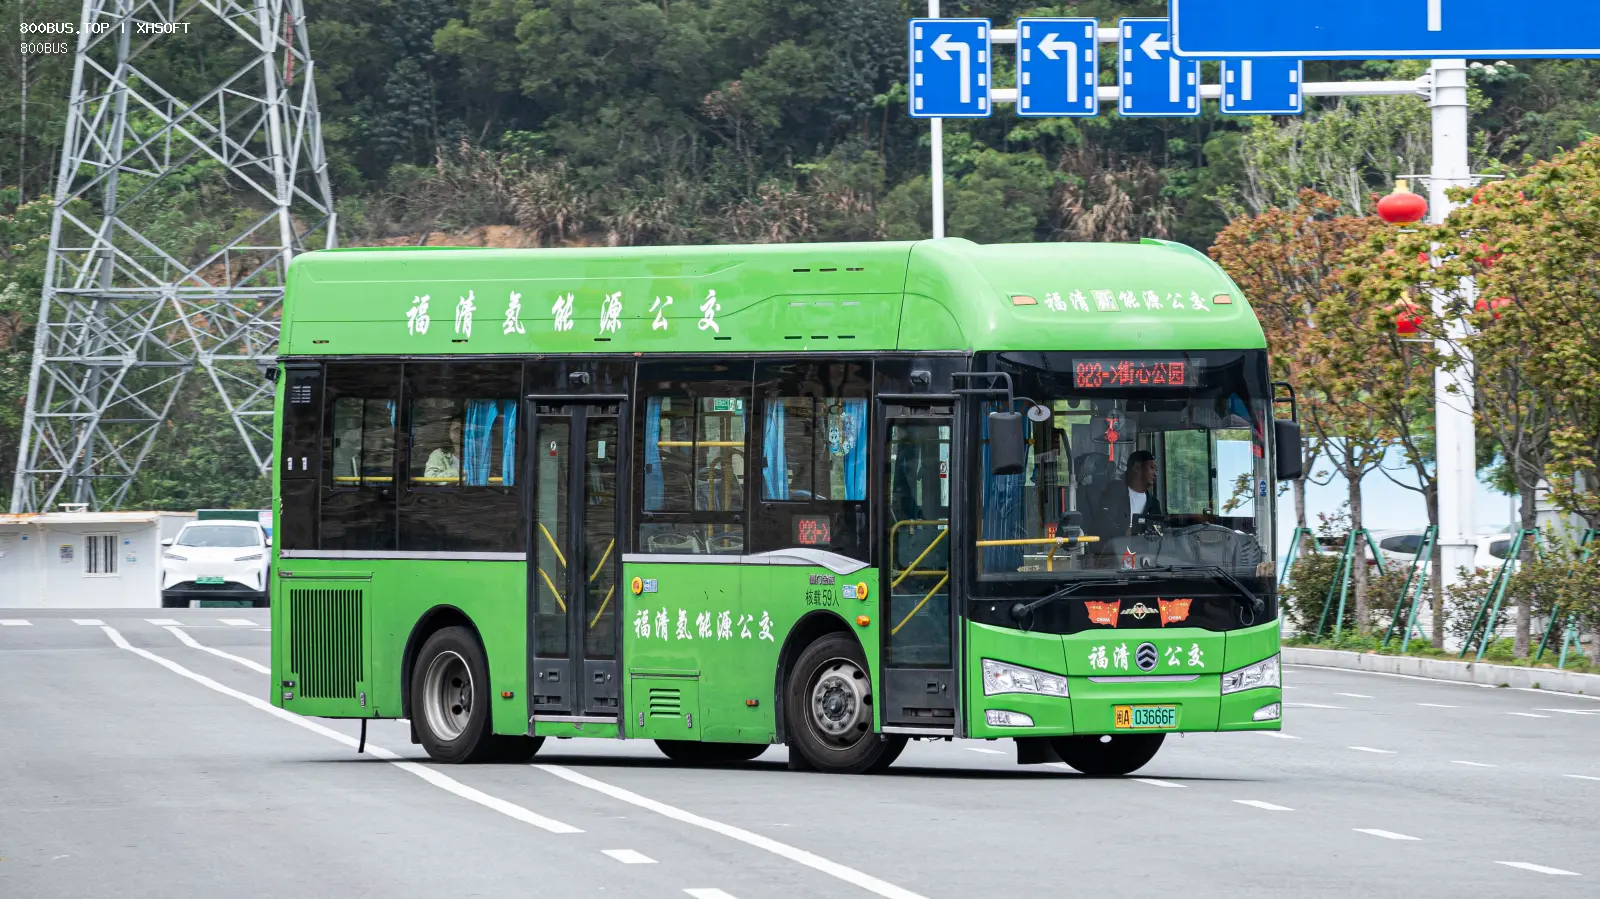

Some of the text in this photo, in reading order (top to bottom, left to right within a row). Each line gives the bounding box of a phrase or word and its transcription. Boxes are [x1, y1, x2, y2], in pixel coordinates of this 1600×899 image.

[406, 290, 721, 338] 福清氢能源公交
[633, 607, 775, 642] 福清氢能源公交
[1087, 643, 1205, 671] 福清 公交
